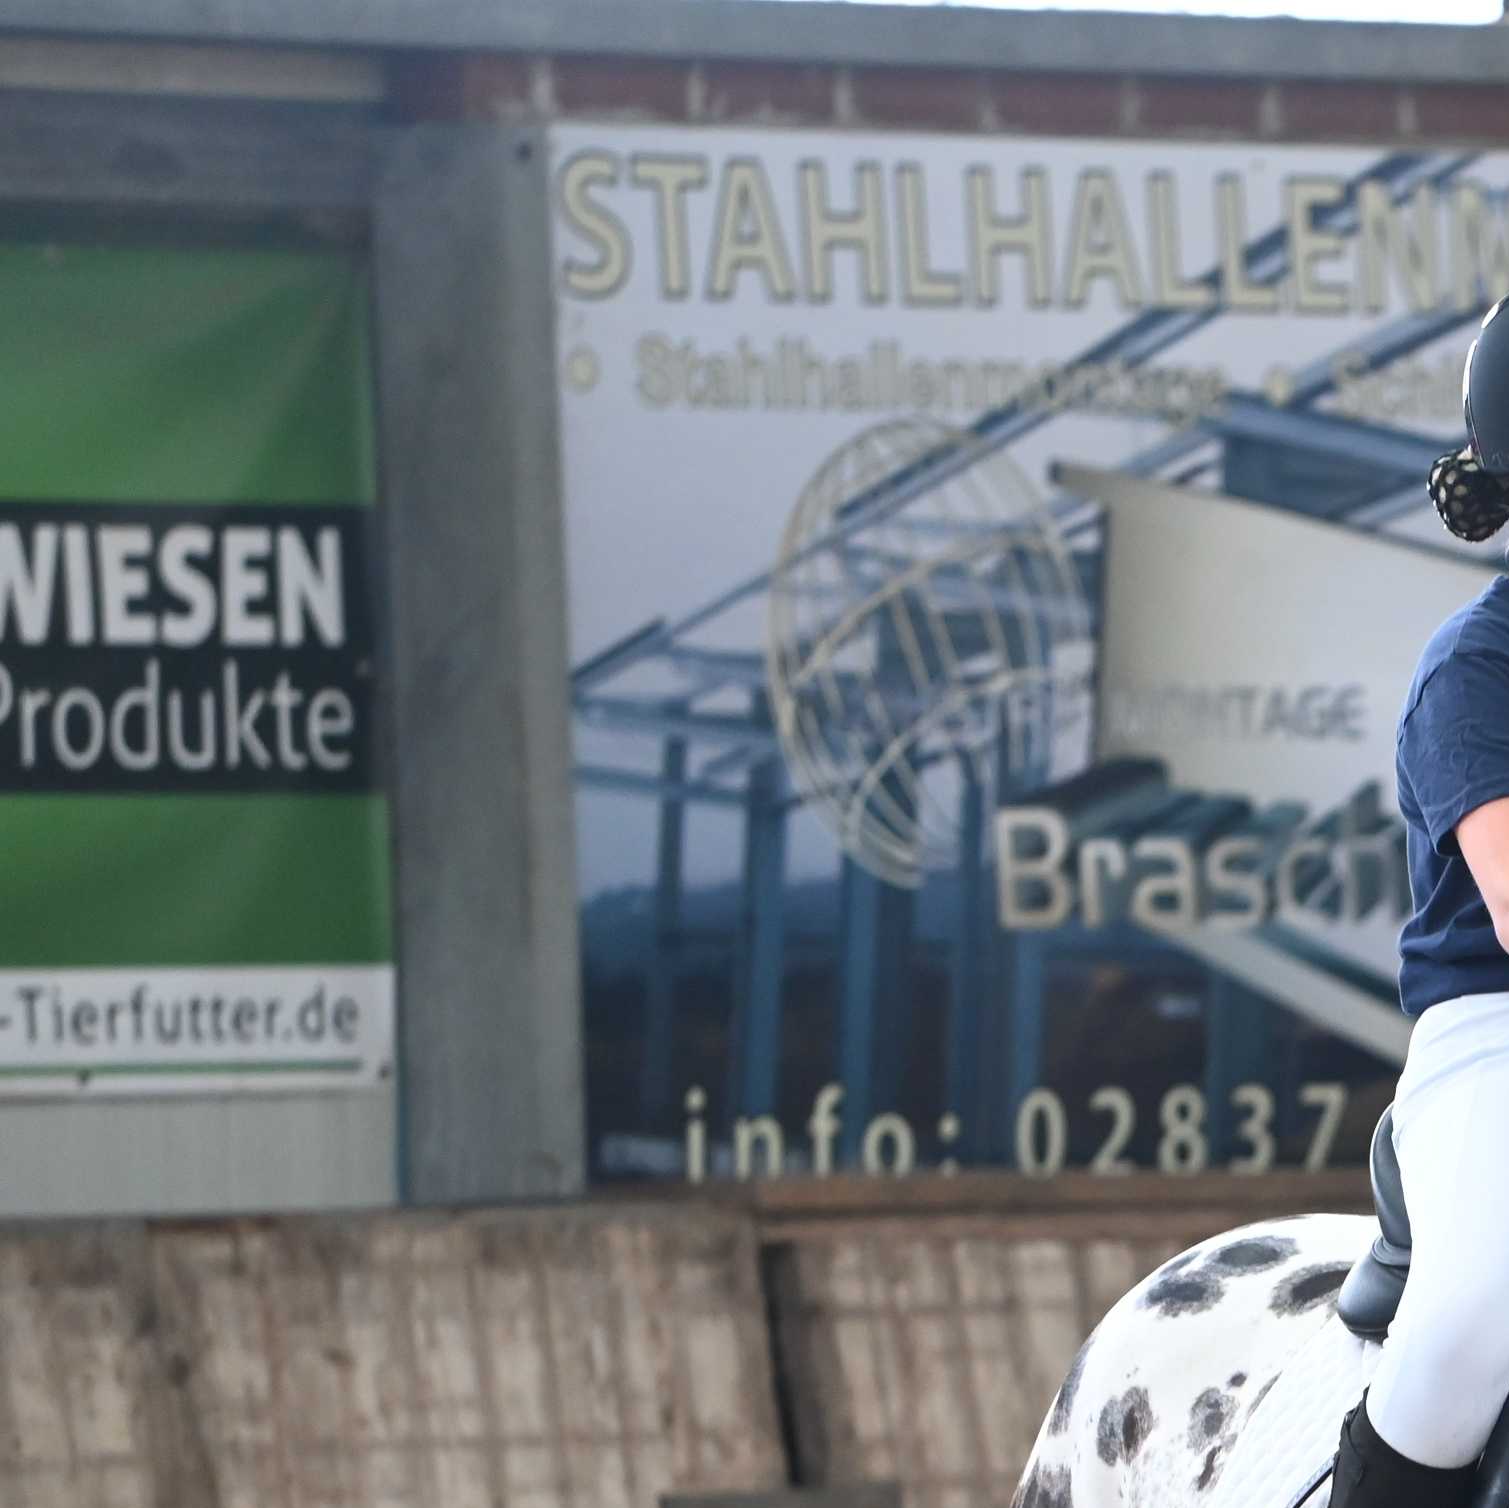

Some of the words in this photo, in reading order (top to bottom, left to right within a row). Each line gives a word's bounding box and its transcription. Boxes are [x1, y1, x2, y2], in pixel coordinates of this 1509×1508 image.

[0, 522, 345, 648] WIESEN
[999, 805, 1410, 931] Brasch
[0, 981, 361, 1047] -Tierfutter.de
[683, 1082, 960, 1186] info:
[1015, 1082, 1350, 1180] 02837
